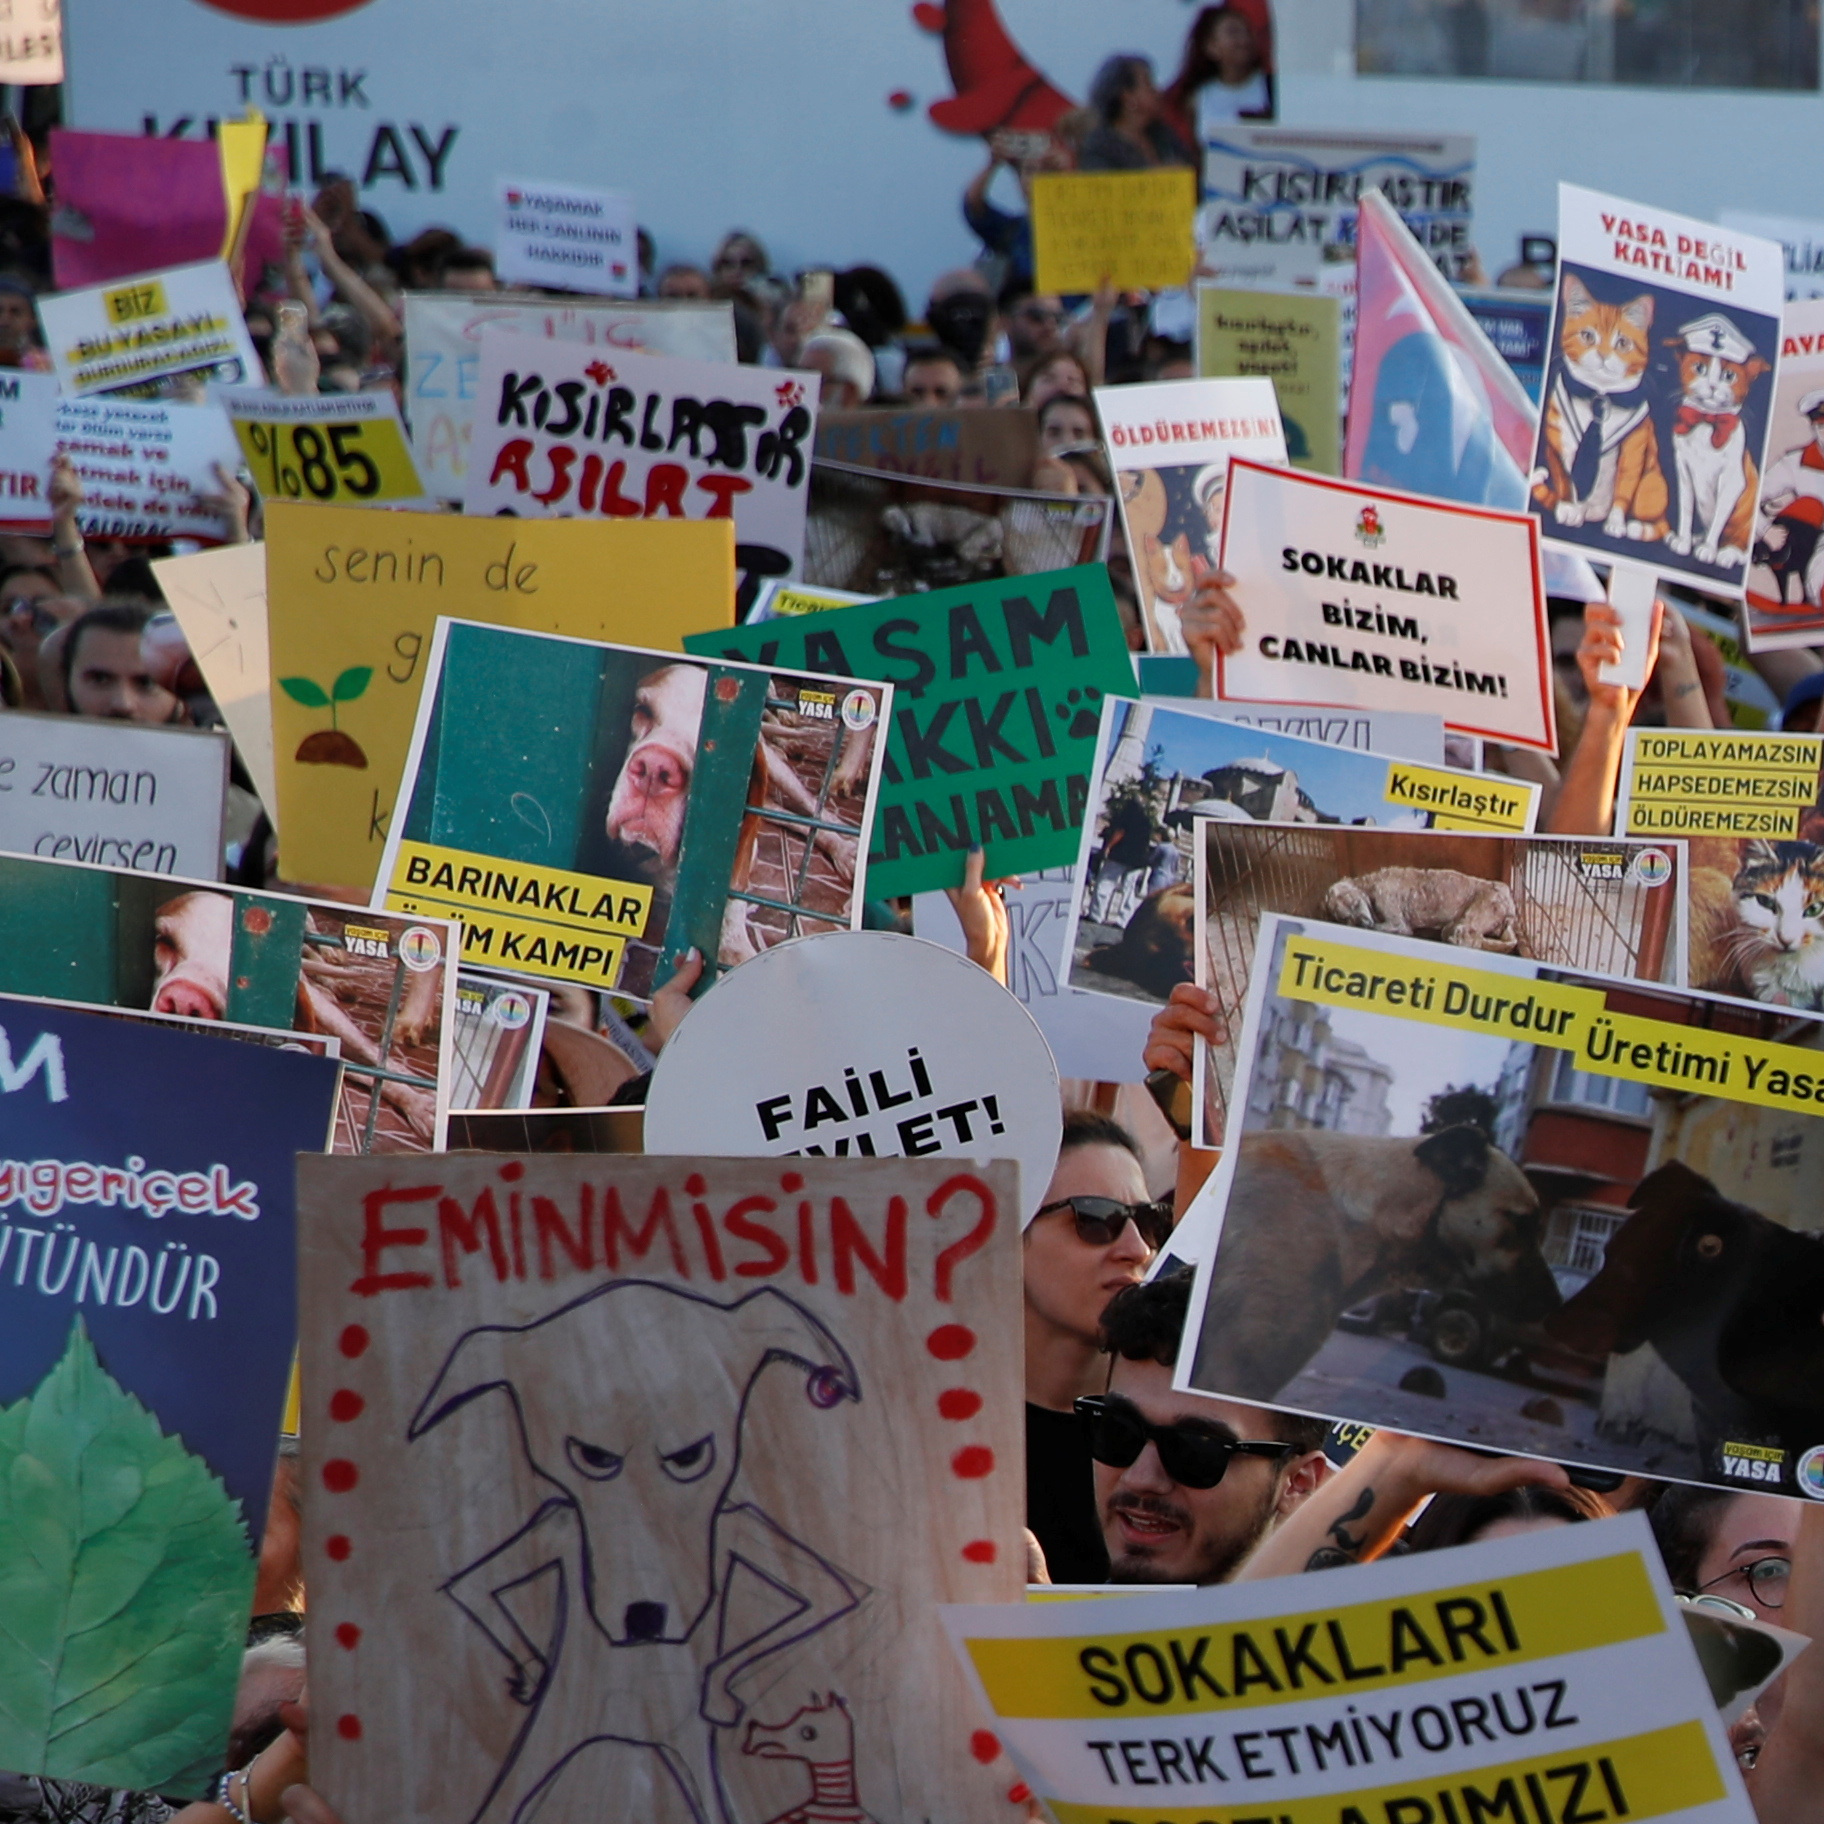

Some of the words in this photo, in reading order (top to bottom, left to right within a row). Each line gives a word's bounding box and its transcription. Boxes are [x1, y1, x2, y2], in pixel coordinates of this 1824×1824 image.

[232, 60, 368, 108] TÜRK
[1601, 213, 1668, 249] YASA
[1677, 234, 1747, 273] DEĞİL
[1614, 241, 1735, 290] KATLİAM!
[114, 286, 154, 322] BİZ
[1111, 415, 1278, 450] ÖLDÜREMEZSİN!
[250, 423, 378, 498] %85
[315, 541, 445, 587] senin
[485, 539, 541, 595] de
[1281, 546, 1458, 602] SOKAKLAR
[1320, 600, 1429, 643] BİZİM,
[1258, 635, 1394, 680] CANLAR
[1398, 656, 1508, 700] BİZİM!
[800, 702, 833, 720] YASA
[1639, 738, 1817, 766] TOPLAYAMAZSIN
[31, 761, 157, 806] zaman
[1390, 771, 1521, 820] Kısırlaştır
[1638, 769, 1813, 801] HAPSEDEMEZSİN
[1632, 802, 1795, 834] ÖLDÜREMEZSİN
[406, 855, 642, 928] BARINAKLAR
[1582, 864, 1623, 879] YASA
[345, 937, 389, 959] YASA
[500, 932, 614, 977] KAMPI
[1292, 953, 1436, 1011] Ticareti
[1444, 981, 1576, 1037] Durdur
[1585, 1016, 1732, 1086] Üretimi
[755, 1046, 939, 1142] FAİLİ
[351, 1160, 998, 1304] EMİNMİSİN?
[1723, 1456, 1781, 1482] YASA
[1724, 1444, 1760, 1458] yaşam
[1078, 1592, 1521, 1708] SOKAKLARI
[1087, 1737, 1226, 1788] TERK
[1242, 1680, 1579, 1779] ETMİYORUZ
